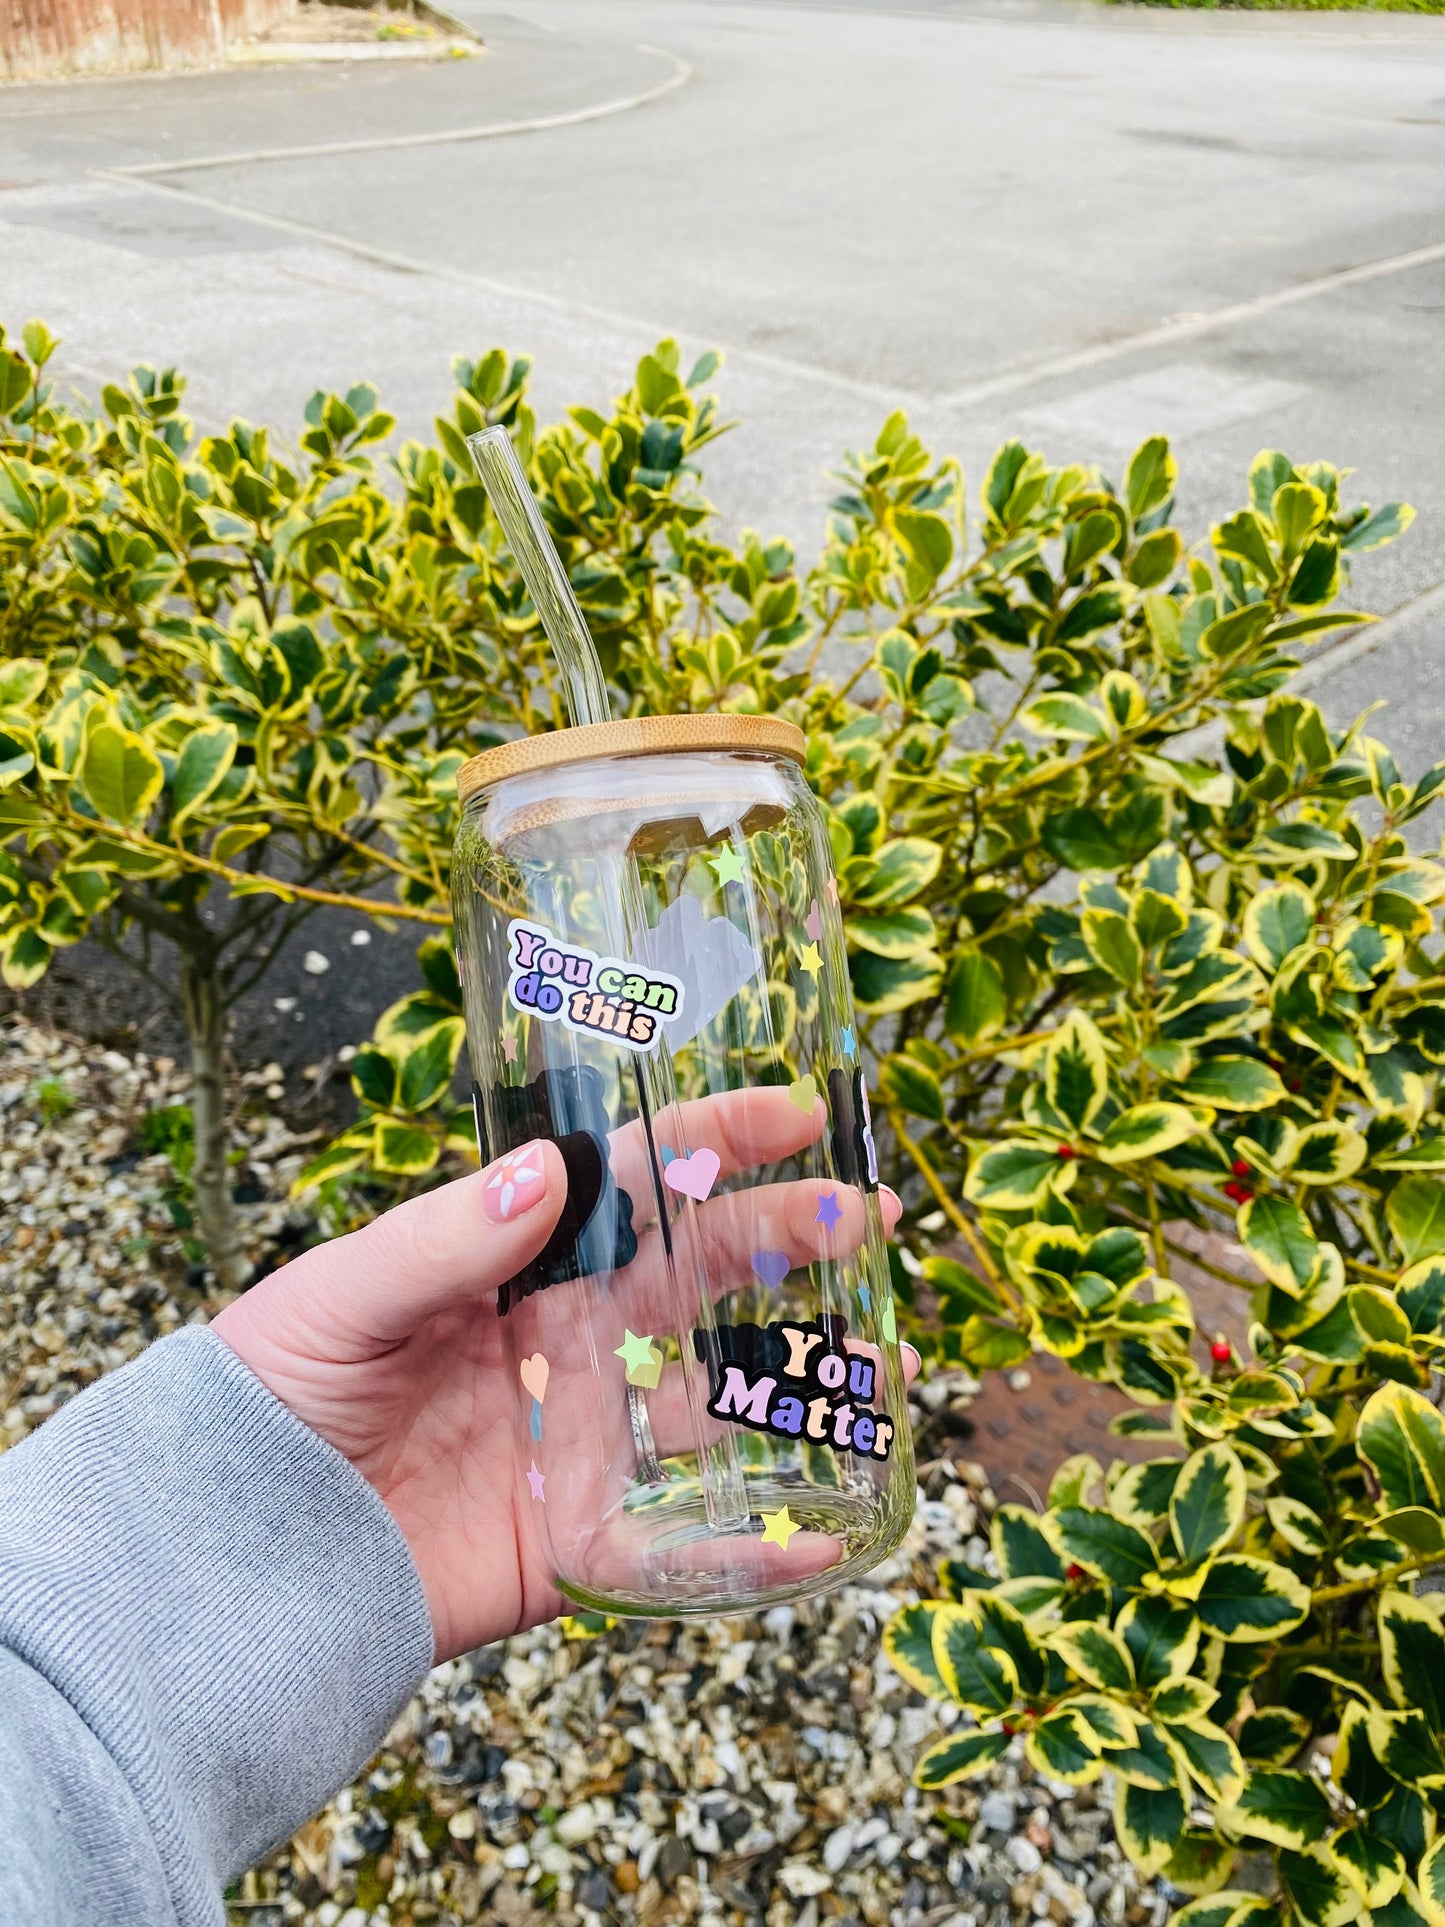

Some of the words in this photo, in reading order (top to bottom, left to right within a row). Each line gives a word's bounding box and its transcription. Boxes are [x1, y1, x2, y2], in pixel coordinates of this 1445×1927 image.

[515, 929, 592, 987] You
[597, 967, 678, 1014] can
[515, 972, 563, 1014] do
[568, 990, 656, 1044] this
[782, 1327, 874, 1398] You
[714, 1366, 893, 1456] Matter
